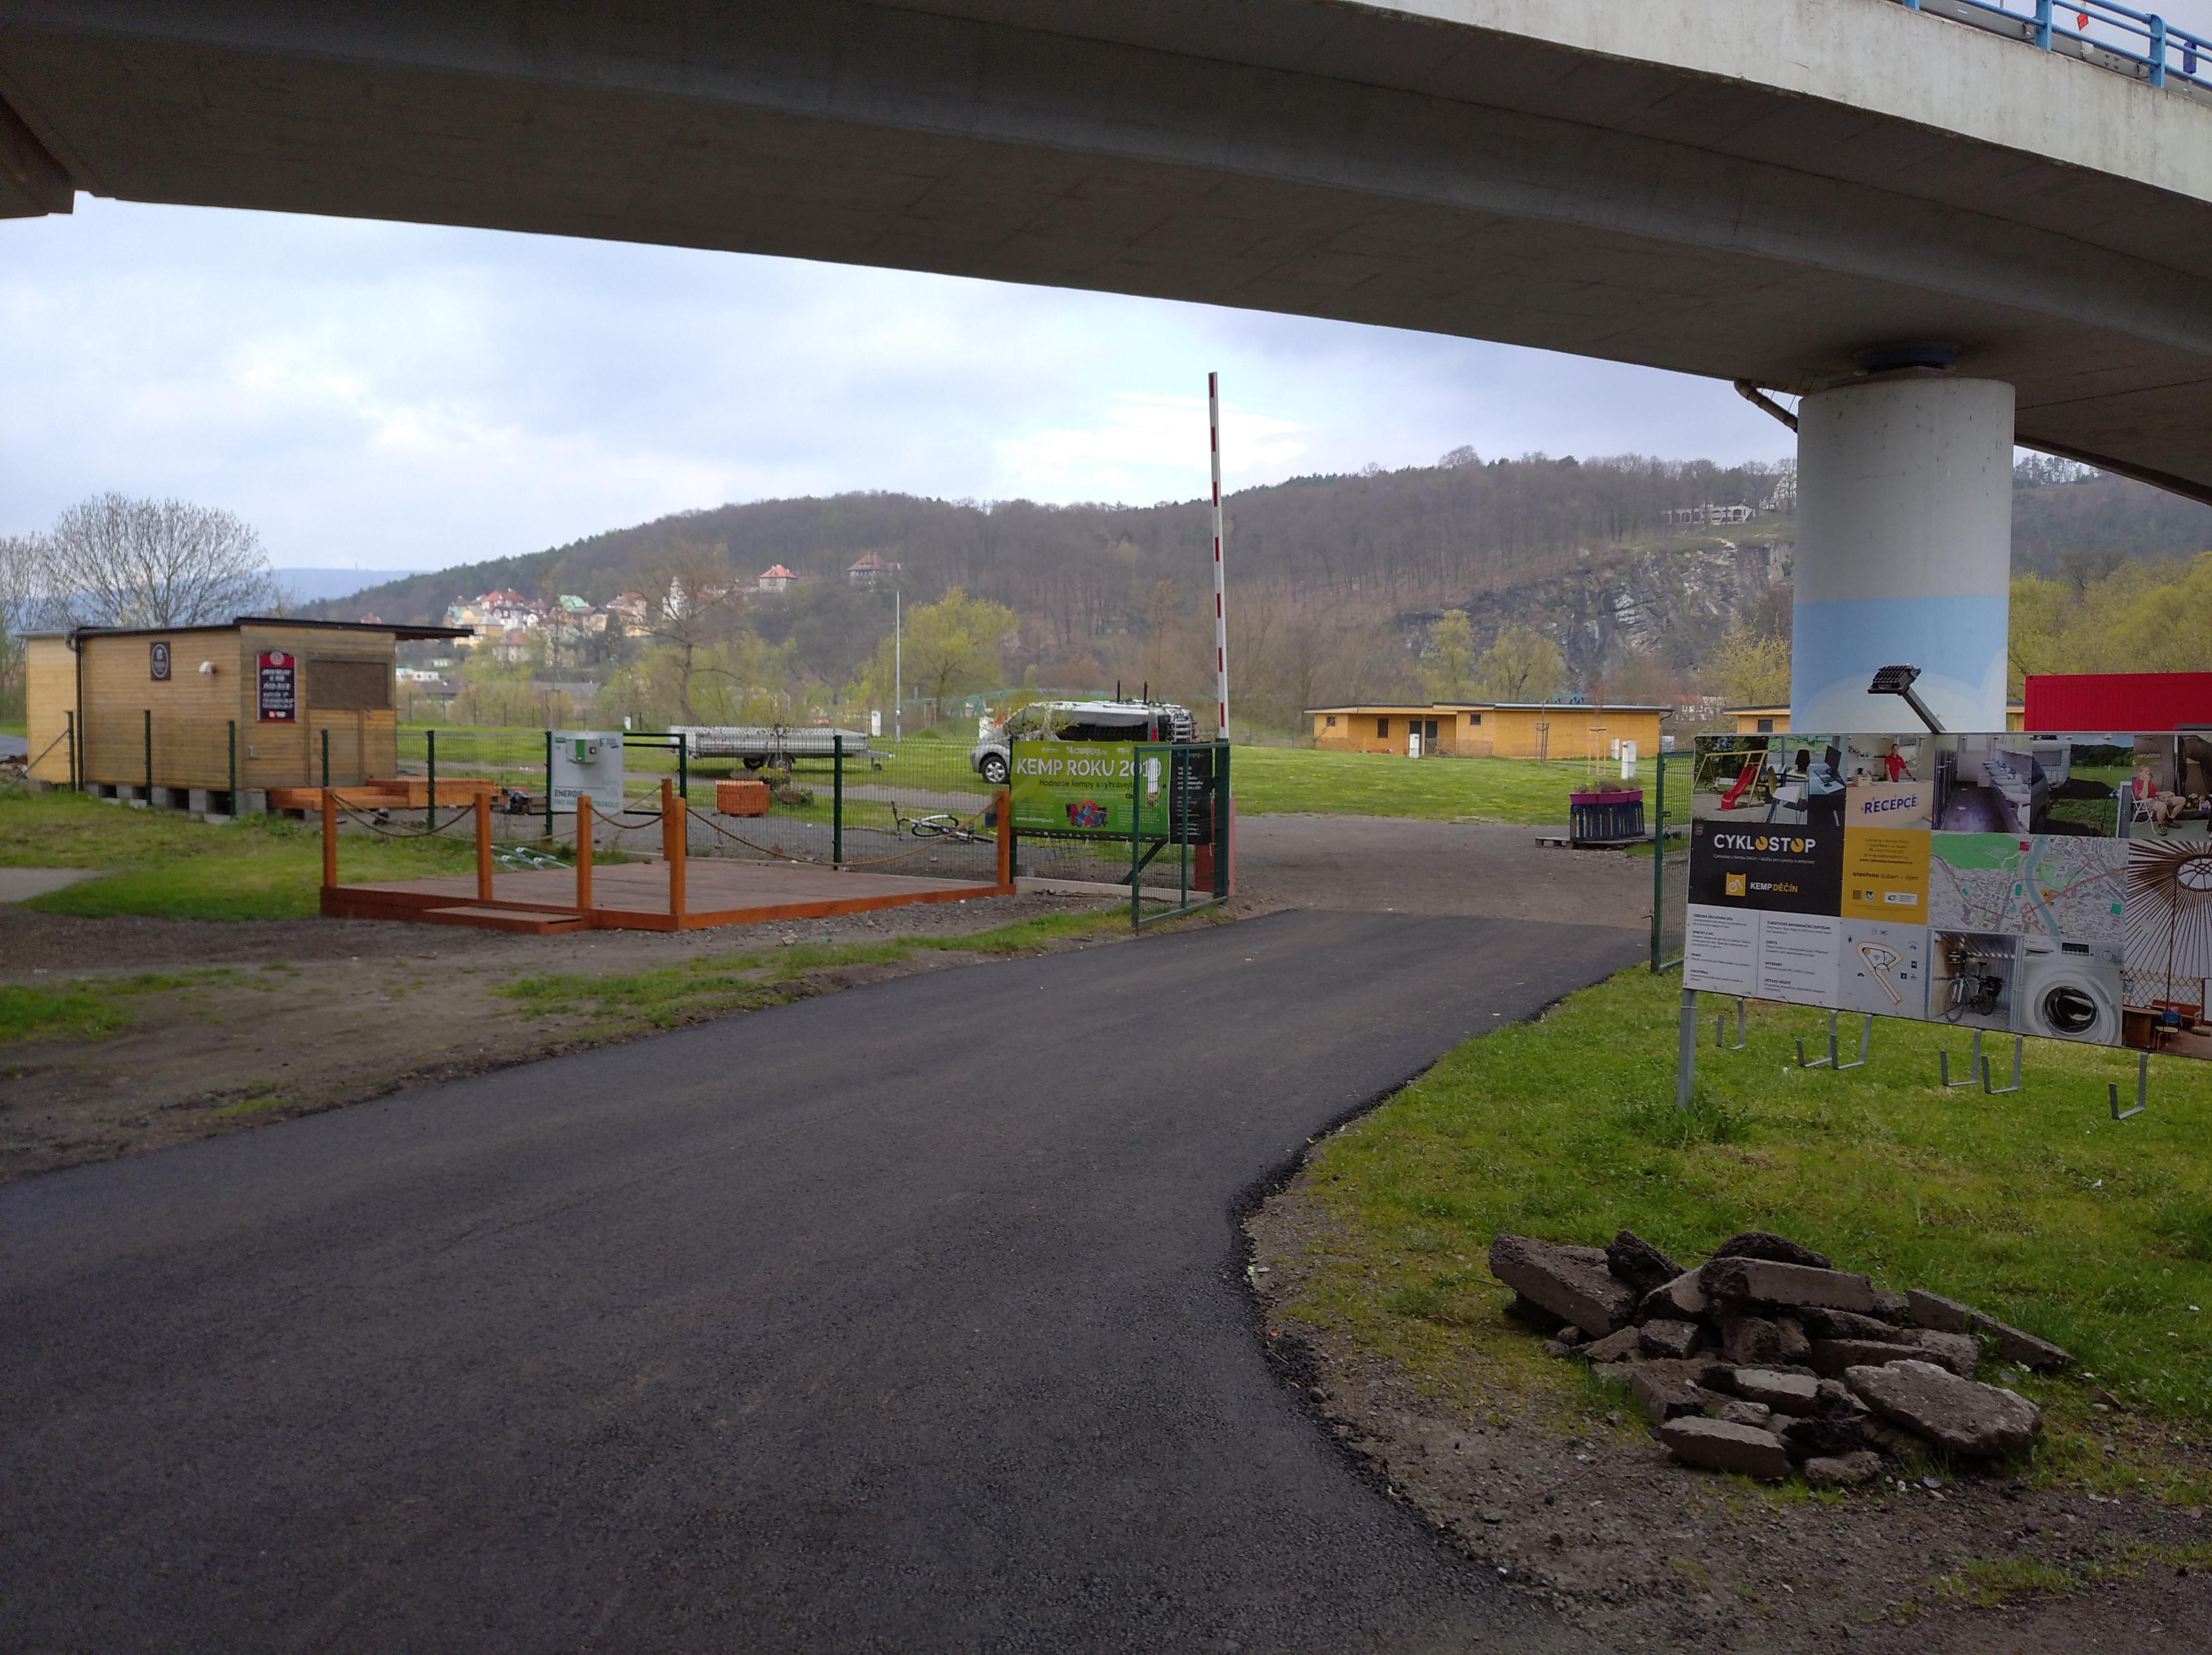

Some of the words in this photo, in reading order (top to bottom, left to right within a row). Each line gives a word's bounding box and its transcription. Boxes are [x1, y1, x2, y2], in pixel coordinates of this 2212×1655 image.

[1016, 758, 1063, 776] KEMP
[1067, 759, 1115, 777] ROKU
[1119, 759, 1161, 778] 201
[1864, 797, 1918, 814] RECEPCE
[1714, 833, 1817, 853] CYKLOSTOP
